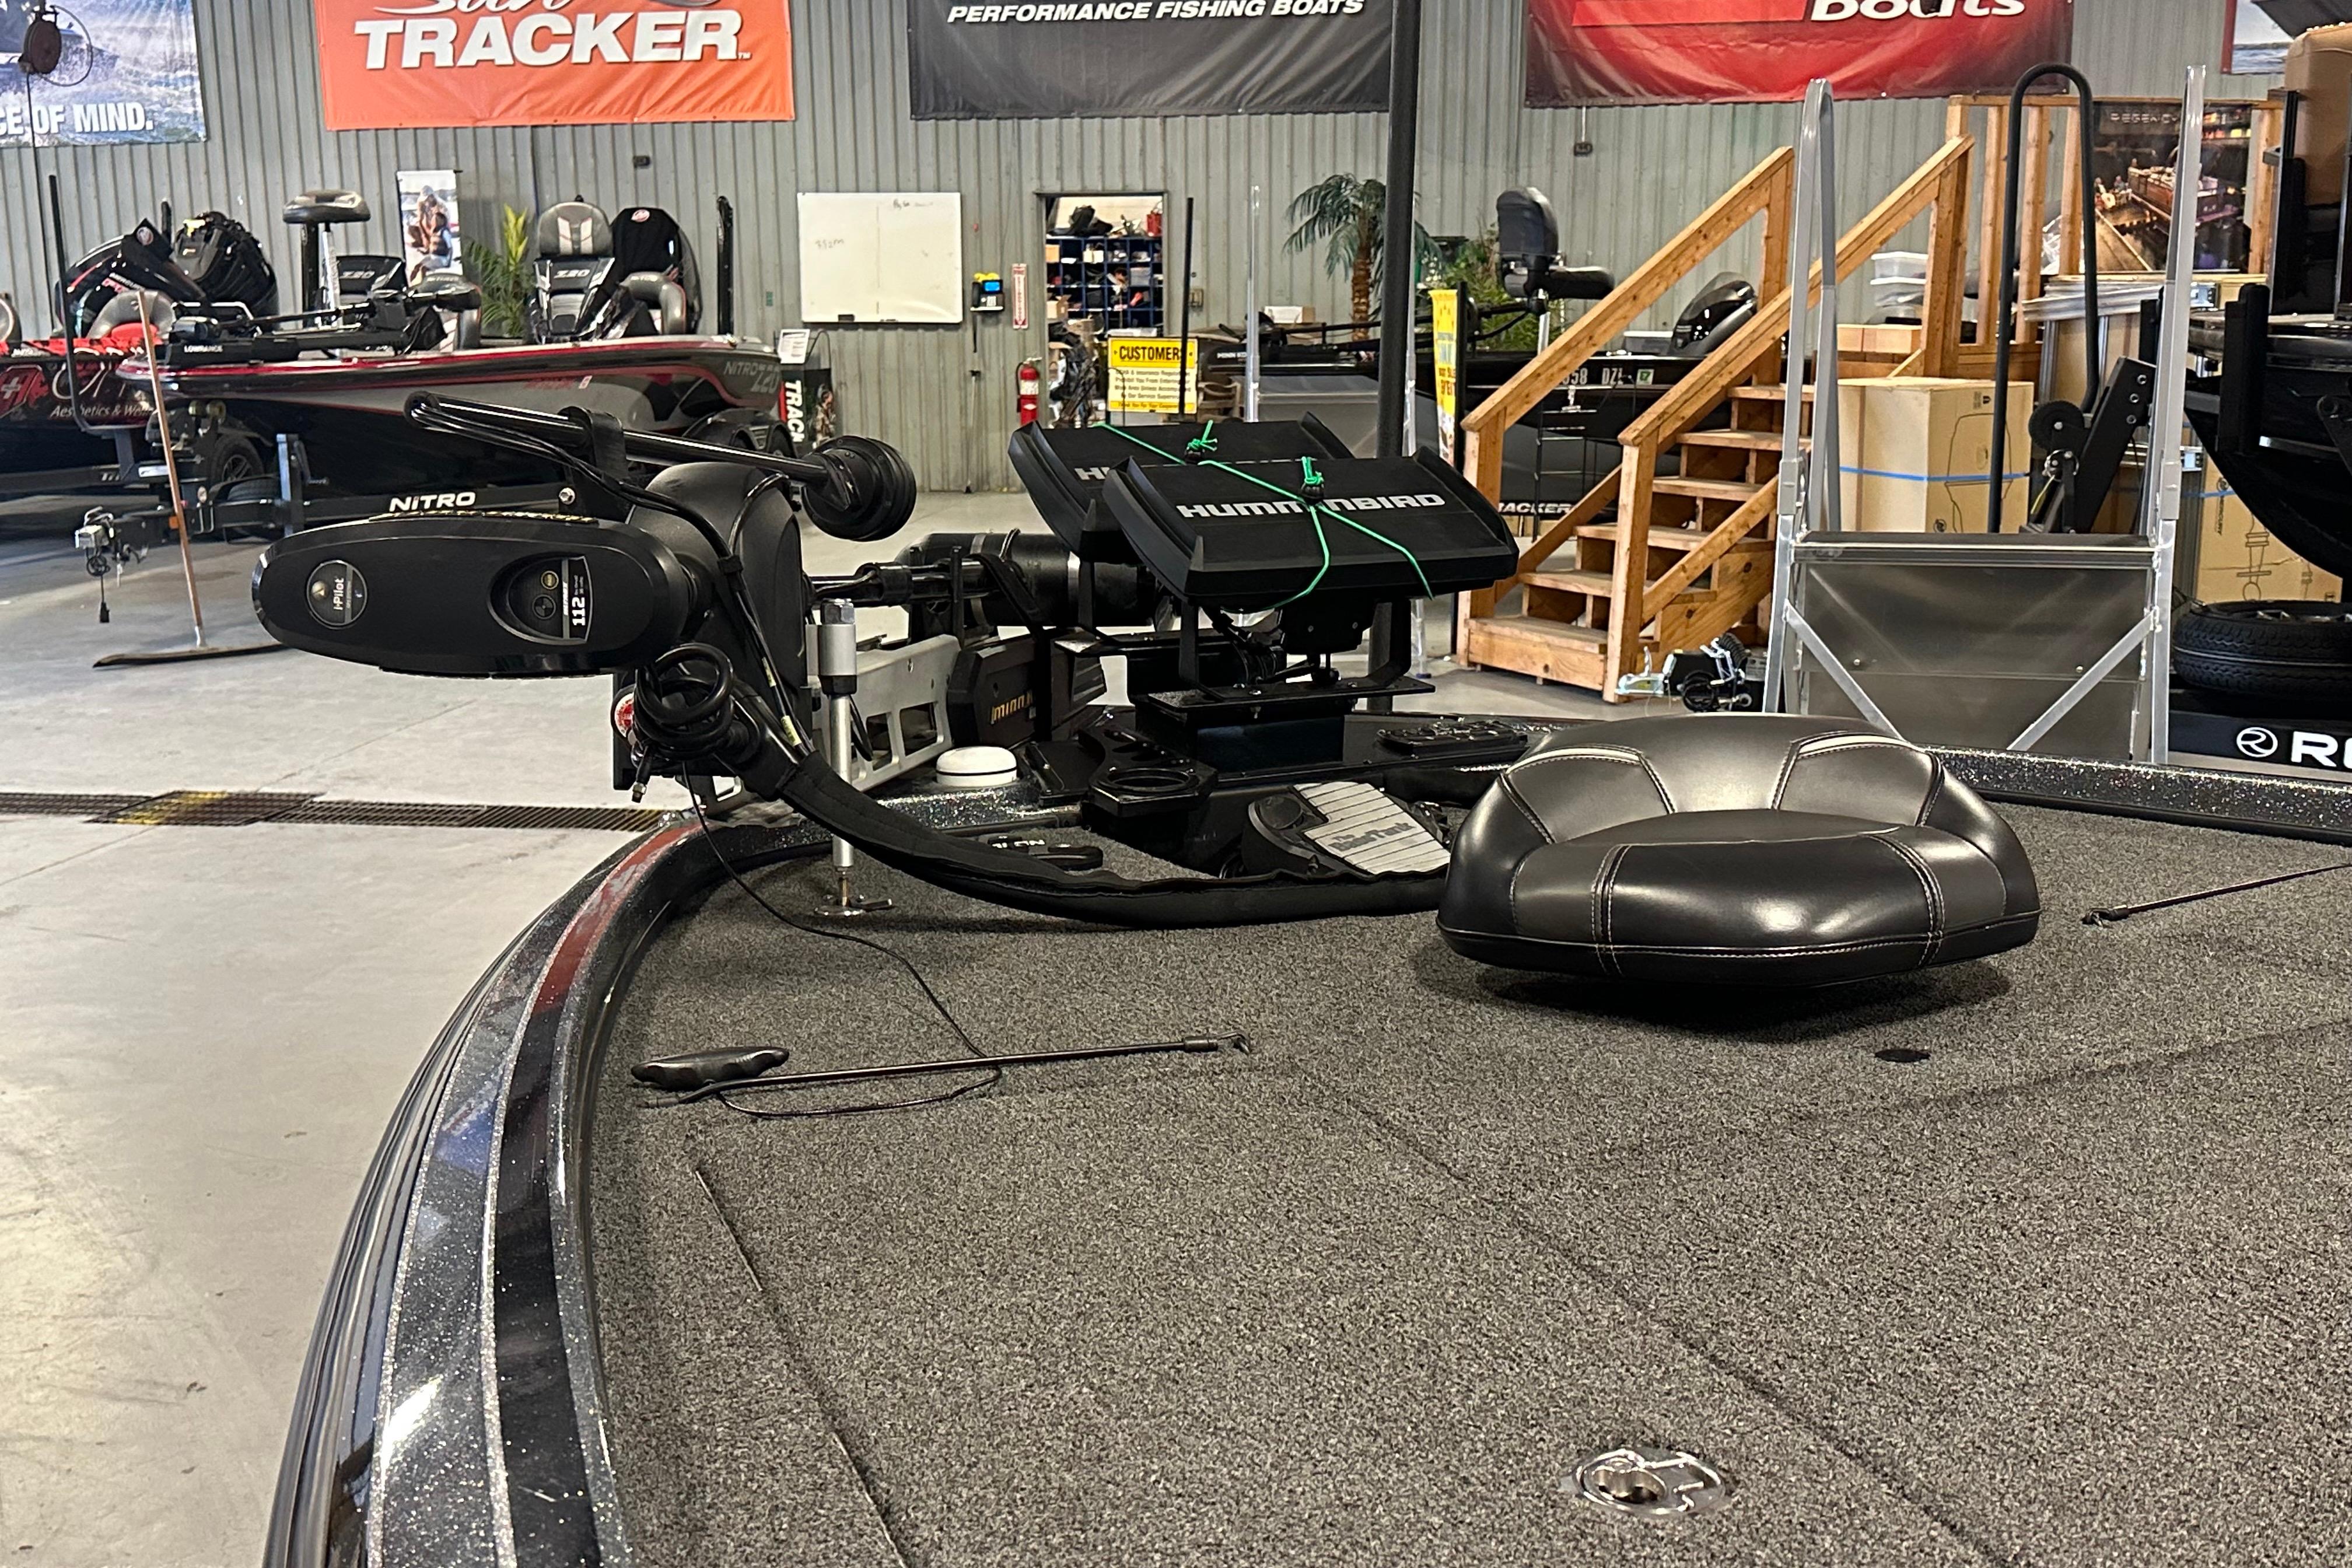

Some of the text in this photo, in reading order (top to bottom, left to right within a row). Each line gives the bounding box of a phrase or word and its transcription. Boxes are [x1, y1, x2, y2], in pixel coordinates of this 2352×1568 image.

[947, 0, 1365, 22] PERFORMANCE FISHING BOATS
[32, 104, 65, 134] OF
[73, 102, 153, 132] MIND.
[1119, 345, 1181, 360] CUSTOMER
[724, 361, 758, 376] NITRO
[50, 405, 110, 418] Aeshetics
[389, 492, 475, 512] NITRO
[1175, 494, 1446, 518] HUMMNBIRD
[572, 597, 586, 626] 112
[2291, 731, 2352, 770] R
